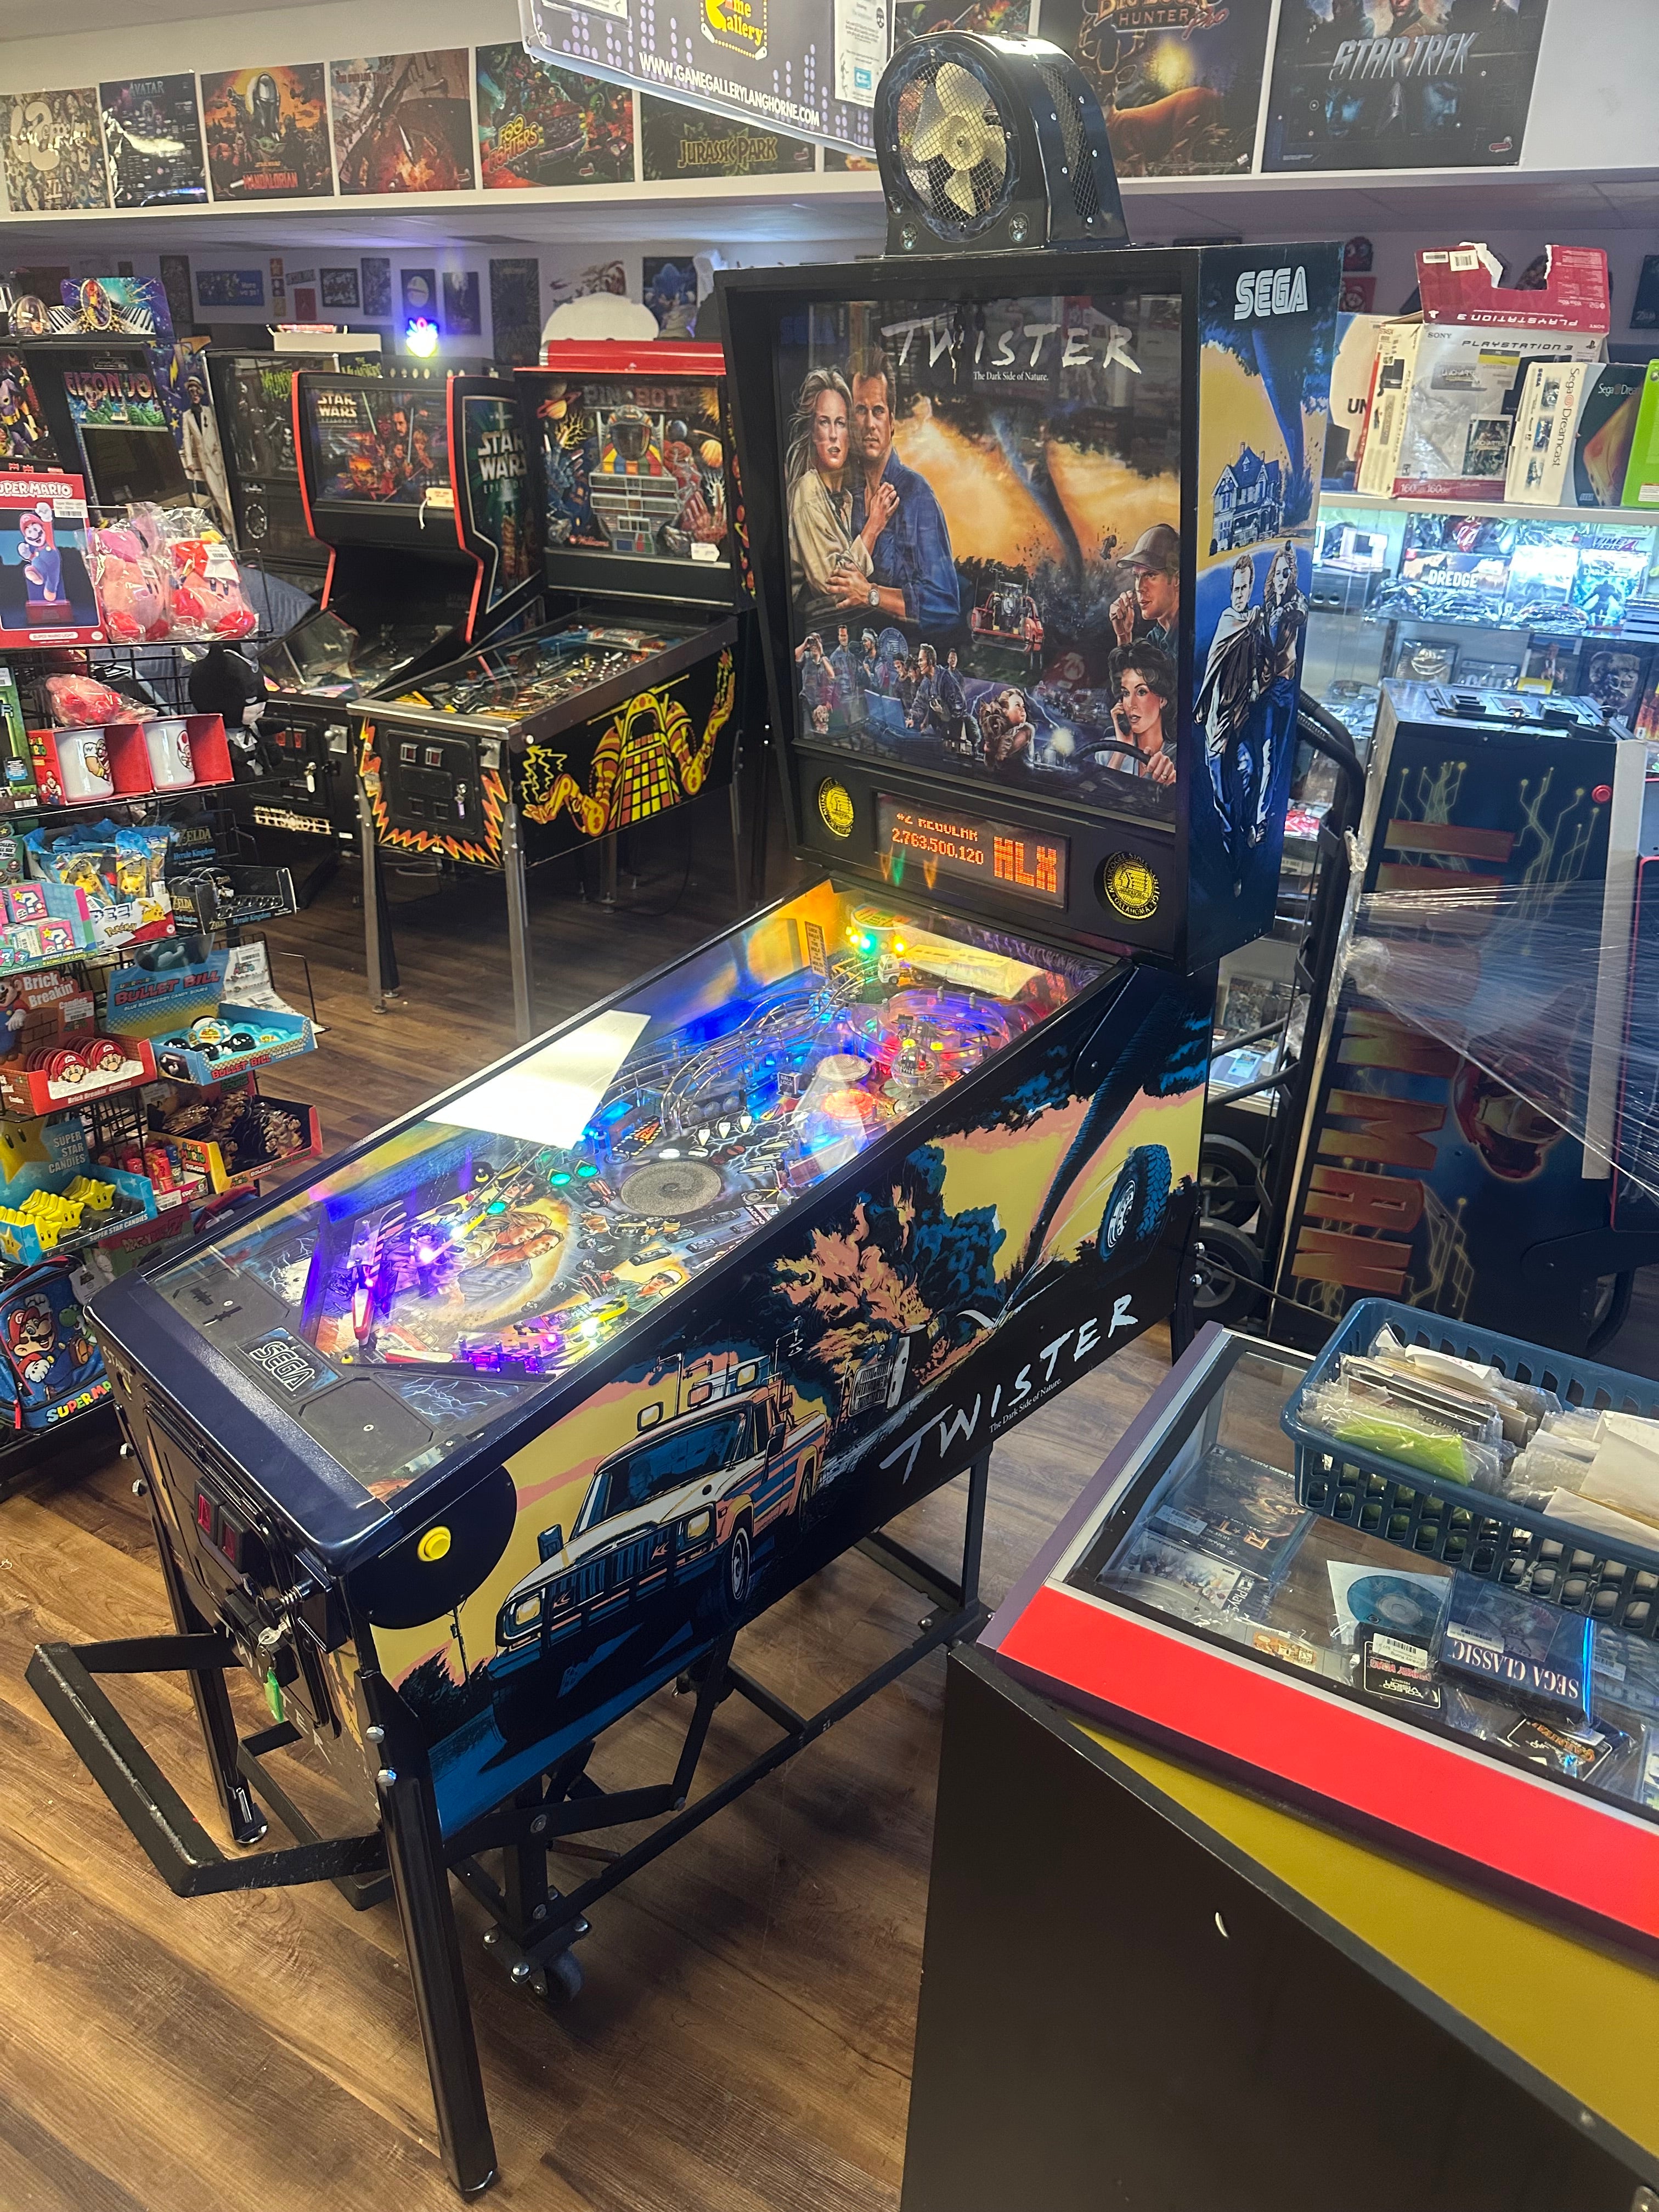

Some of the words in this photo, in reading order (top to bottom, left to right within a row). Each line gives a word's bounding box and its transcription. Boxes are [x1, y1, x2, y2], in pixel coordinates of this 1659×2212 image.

[1120, 9, 1188, 26] HUNTER
[1329, 37, 1411, 81] STAR
[1406, 32, 1481, 76] TREK
[129, 81, 163, 94] AVATAR
[639, 53, 820, 127] WWW.GAMEGALLERYLANGHORNE.COM
[499, 114, 524, 142] FOO
[488, 122, 541, 171] FIGHTERS
[678, 139, 737, 168] JURASSIC
[737, 137, 778, 162] PARK
[1234, 267, 1308, 320] SEGA
[1470, 313, 1578, 326] PLAYSTATION
[881, 308, 1141, 374] TWISTER
[1462, 340, 1561, 350] PLAYSTATION
[64, 372, 122, 397] ELTON
[974, 371, 985, 380] The
[986, 371, 1002, 381] Dark
[1003, 372, 1015, 381] Side
[1017, 372, 1024, 381] of
[1025, 373, 1049, 381] Nature.
[1566, 368, 1579, 397] Sega
[318, 393, 356, 405] STAR
[1598, 383, 1613, 396] Sega
[319, 406, 357, 417] WARS
[1552, 409, 1572, 467] Dreamcast
[29, 482, 73, 498] MARIO
[1429, 569, 1479, 588] DREDGE
[104, 923, 138, 936] Pokémon
[23, 973, 59, 991] Brick
[28, 980, 74, 1008] Breakin'
[115, 979, 179, 1006] BULLET
[184, 970, 222, 988] BILL
[138, 996, 169, 1008] RASPBERRY
[171, 990, 189, 999] CANDY
[211, 1062, 247, 1080] BULLET
[250, 1054, 271, 1066] BILL
[67, 1094, 83, 1104] Brick
[53, 1131, 82, 1148] SUPER
[61, 1143, 83, 1158] STAR
[48, 1154, 85, 1174] CANDIES
[89, 1229, 109, 1242] SUPER
[109, 1224, 123, 1236] STAR
[124, 1214, 148, 1229] CANDIES
[249, 1340, 315, 1392] SEGA
[879, 1294, 1139, 1485] TWISTER
[46, 1393, 92, 1423] SUPER
[989, 1421, 1002, 1434] The
[1002, 1408, 1019, 1425] Dark
[1019, 1399, 1032, 1413] Side
[1032, 1390, 1041, 1407] of
[1041, 1378, 1062, 1398] Nature.
[1421, 1414, 1469, 1436] XCLUSIVE
[1453, 1639, 1526, 1681] CLASSIC
[1533, 1666, 1579, 1699] SEGA
